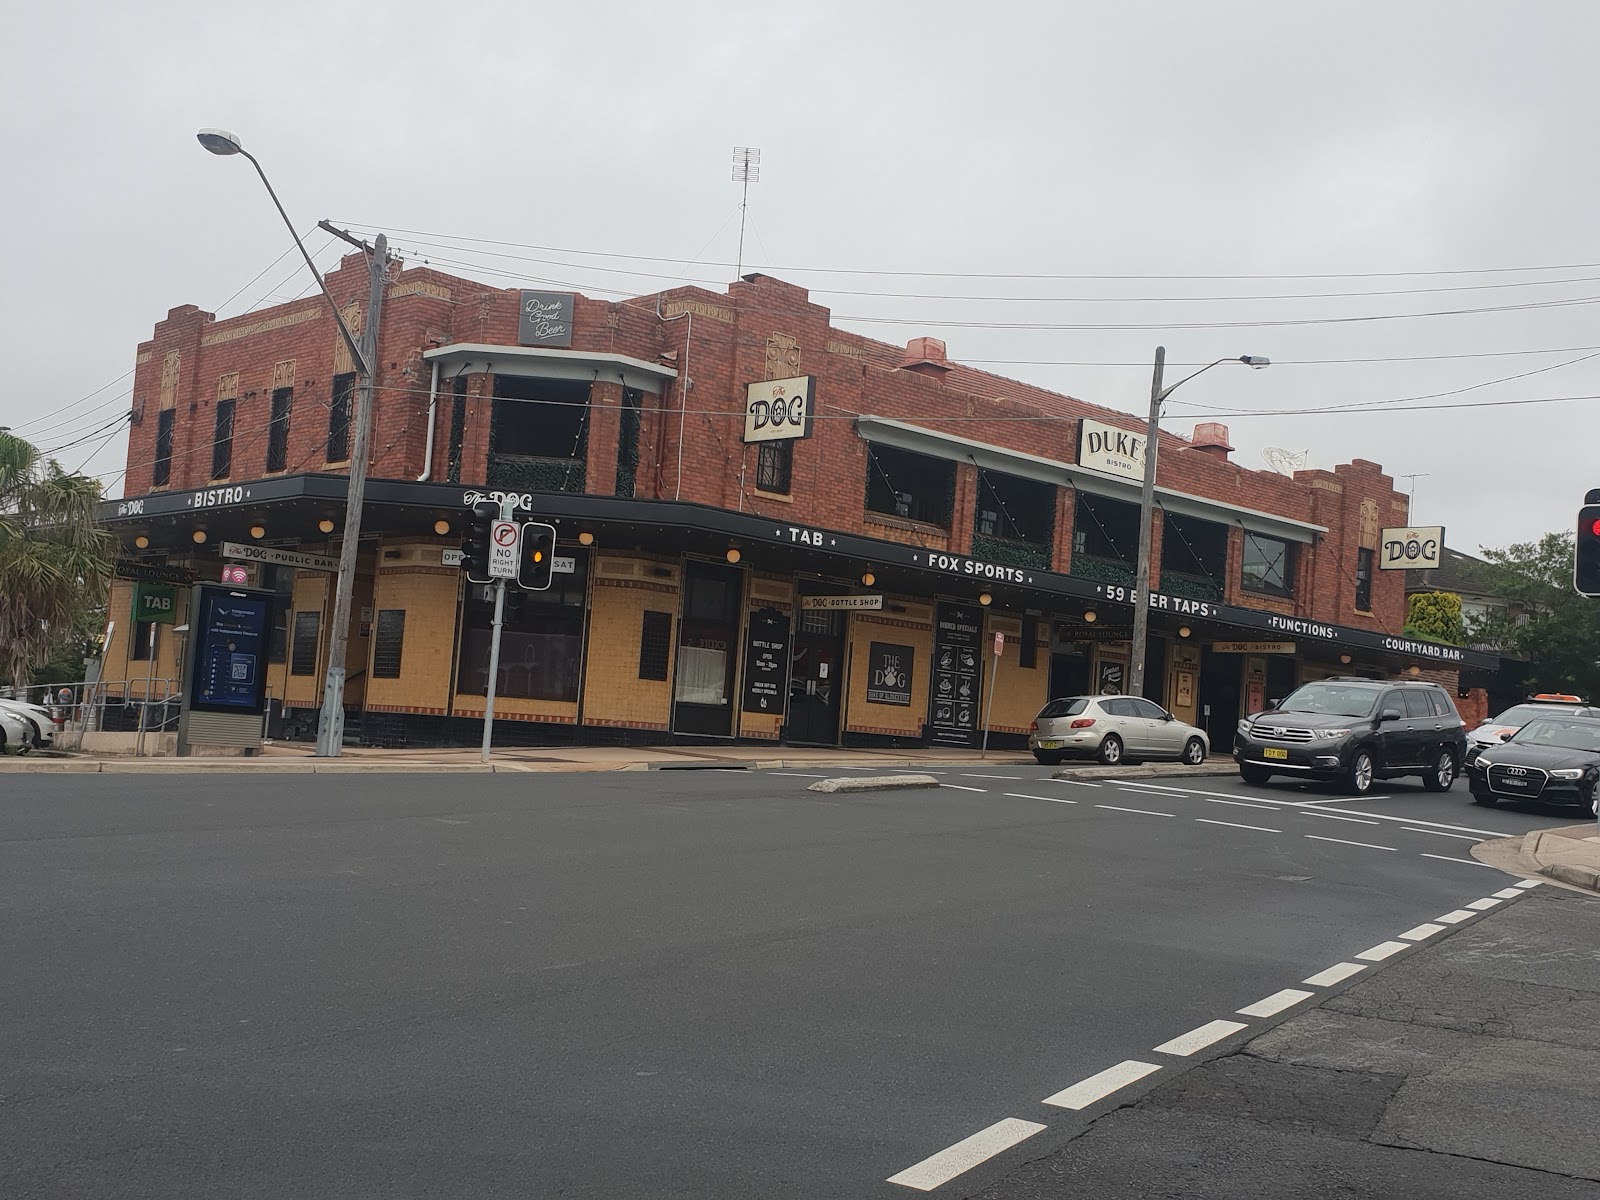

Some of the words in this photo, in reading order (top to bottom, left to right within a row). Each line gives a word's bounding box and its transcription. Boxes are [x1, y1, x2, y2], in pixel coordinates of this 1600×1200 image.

[525, 299, 562, 312] Drink
[529, 310, 560, 323] Good
[535, 322, 566, 337] Beer
[772, 385, 786, 398] The
[750, 395, 803, 431] DOG
[1106, 458, 1132, 470] BISTRO
[194, 486, 243, 507] BISTRO
[489, 491, 533, 511] DOG
[127, 500, 144, 515] DOG
[789, 527, 824, 546] TAB
[243, 547, 268, 560] DOG
[275, 553, 311, 565] PUBLIC
[314, 558, 333, 567] BAR
[496, 548, 512, 558] NO
[1384, 539, 1436, 561] DOG
[117, 566, 140, 575] OYAL
[492, 559, 514, 567] RIGHT
[493, 566, 513, 575] TURN
[553, 560, 574, 569] SAT
[928, 554, 960, 572] FOX
[964, 560, 1024, 583] SPORTS
[144, 595, 171, 610] TAB
[812, 597, 828, 607] DOG
[1106, 585, 1125, 601] 59
[1130, 589, 1168, 609] BER
[1173, 597, 1209, 616] TAPS
[1272, 616, 1334, 639] FUNCTIONS
[753, 640, 770, 649] BOTTLE
[771, 642, 783, 650] SHOP
[1231, 643, 1248, 651] DOG
[1386, 638, 1440, 657] COURTYARD
[1442, 648, 1460, 660] BAR
[883, 654, 900, 669] THE
